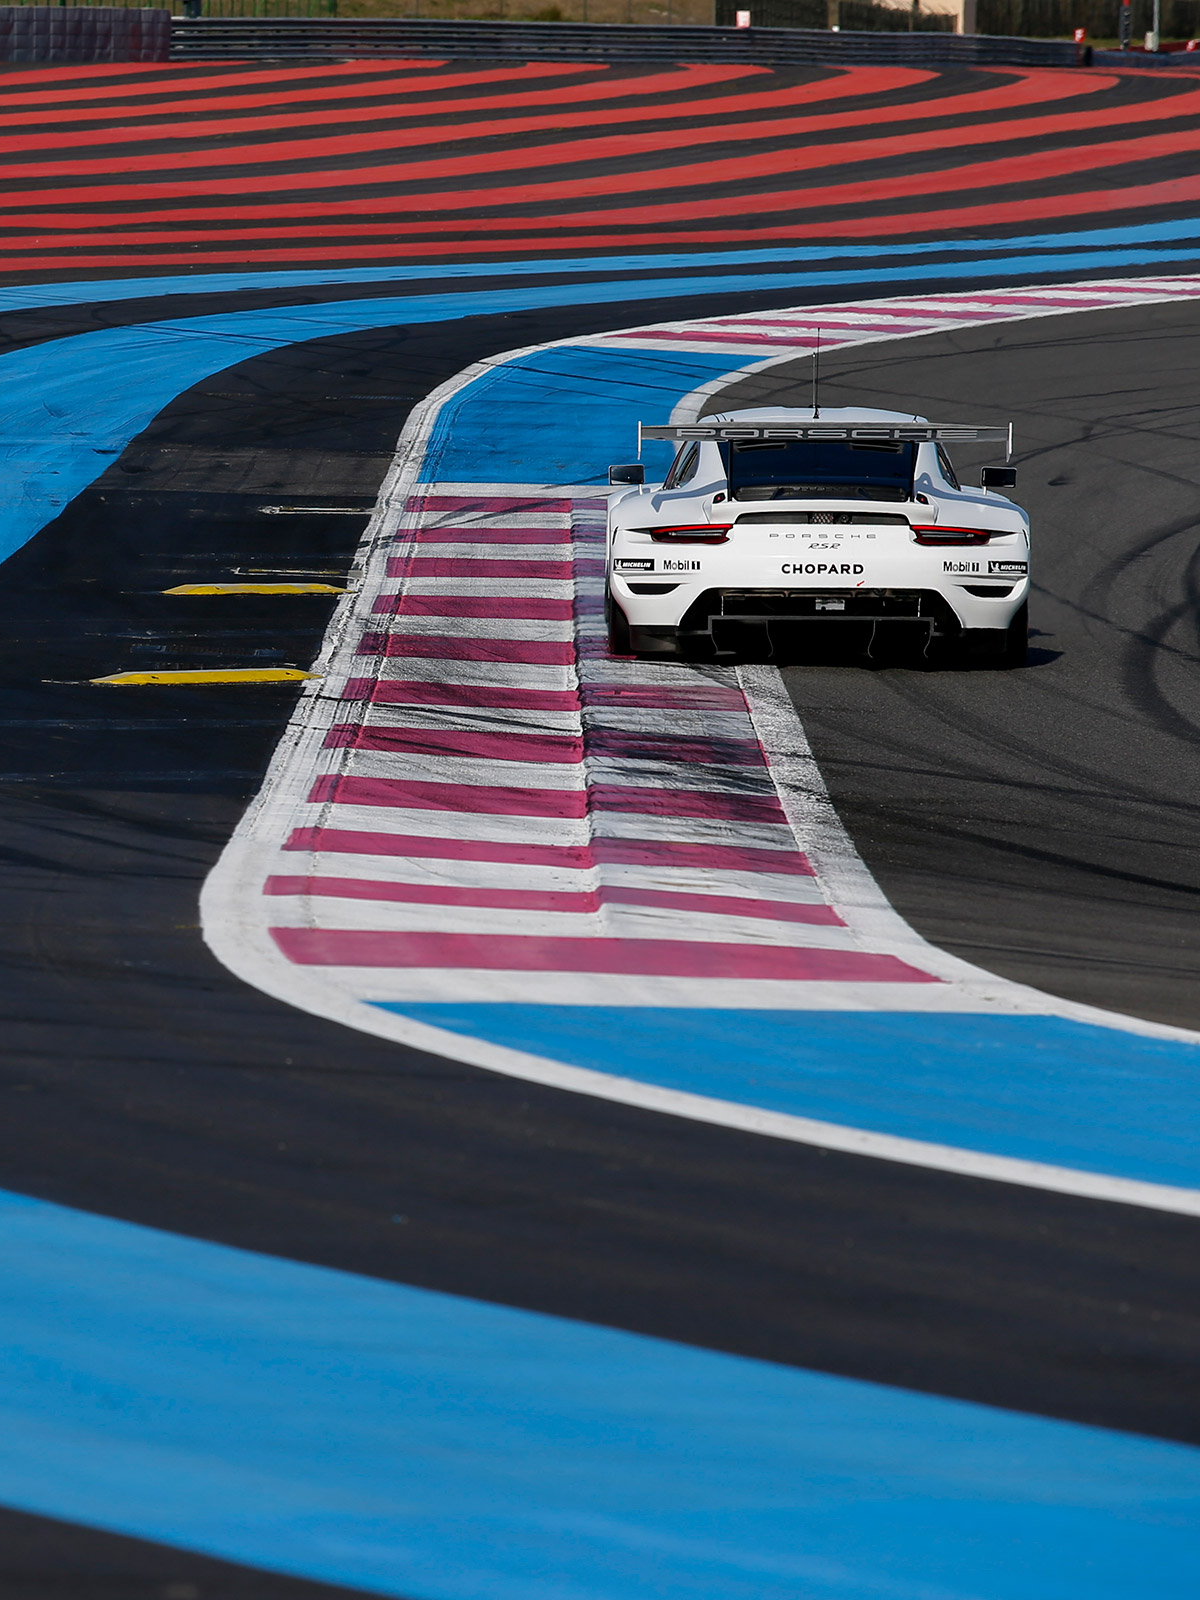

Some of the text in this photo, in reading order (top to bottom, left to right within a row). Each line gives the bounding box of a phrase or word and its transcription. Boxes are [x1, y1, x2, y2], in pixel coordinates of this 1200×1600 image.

[676, 428, 978, 438] PORSCHE
[807, 542, 841, 550] RSR
[781, 563, 864, 575] CHOPARD
